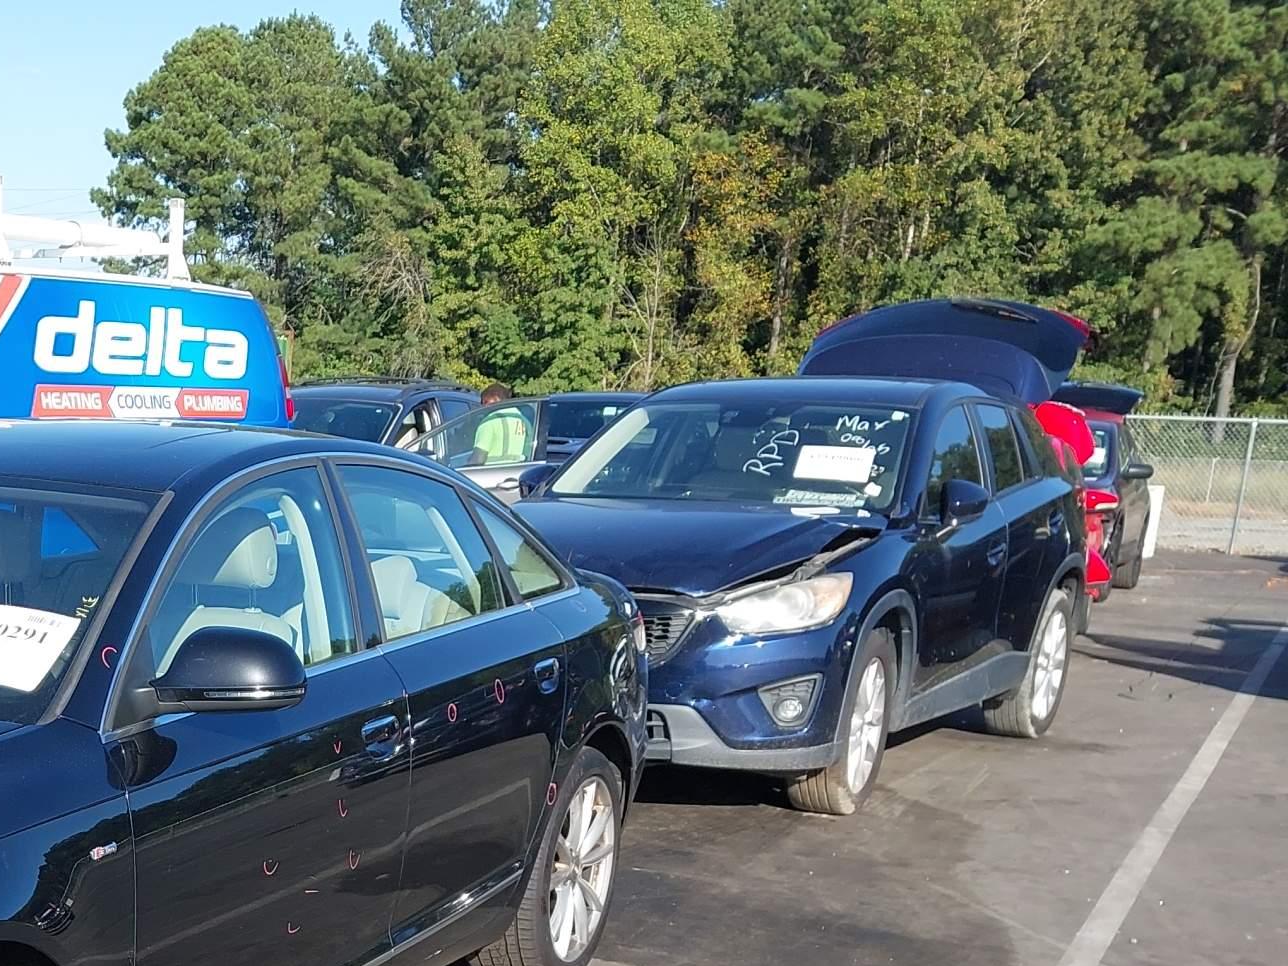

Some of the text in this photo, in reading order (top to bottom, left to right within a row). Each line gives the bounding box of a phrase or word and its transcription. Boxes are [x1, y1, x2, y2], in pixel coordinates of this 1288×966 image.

[33, 300, 249, 380] delta
[40, 391, 243, 413] HEATING COOLING PLUMBING
